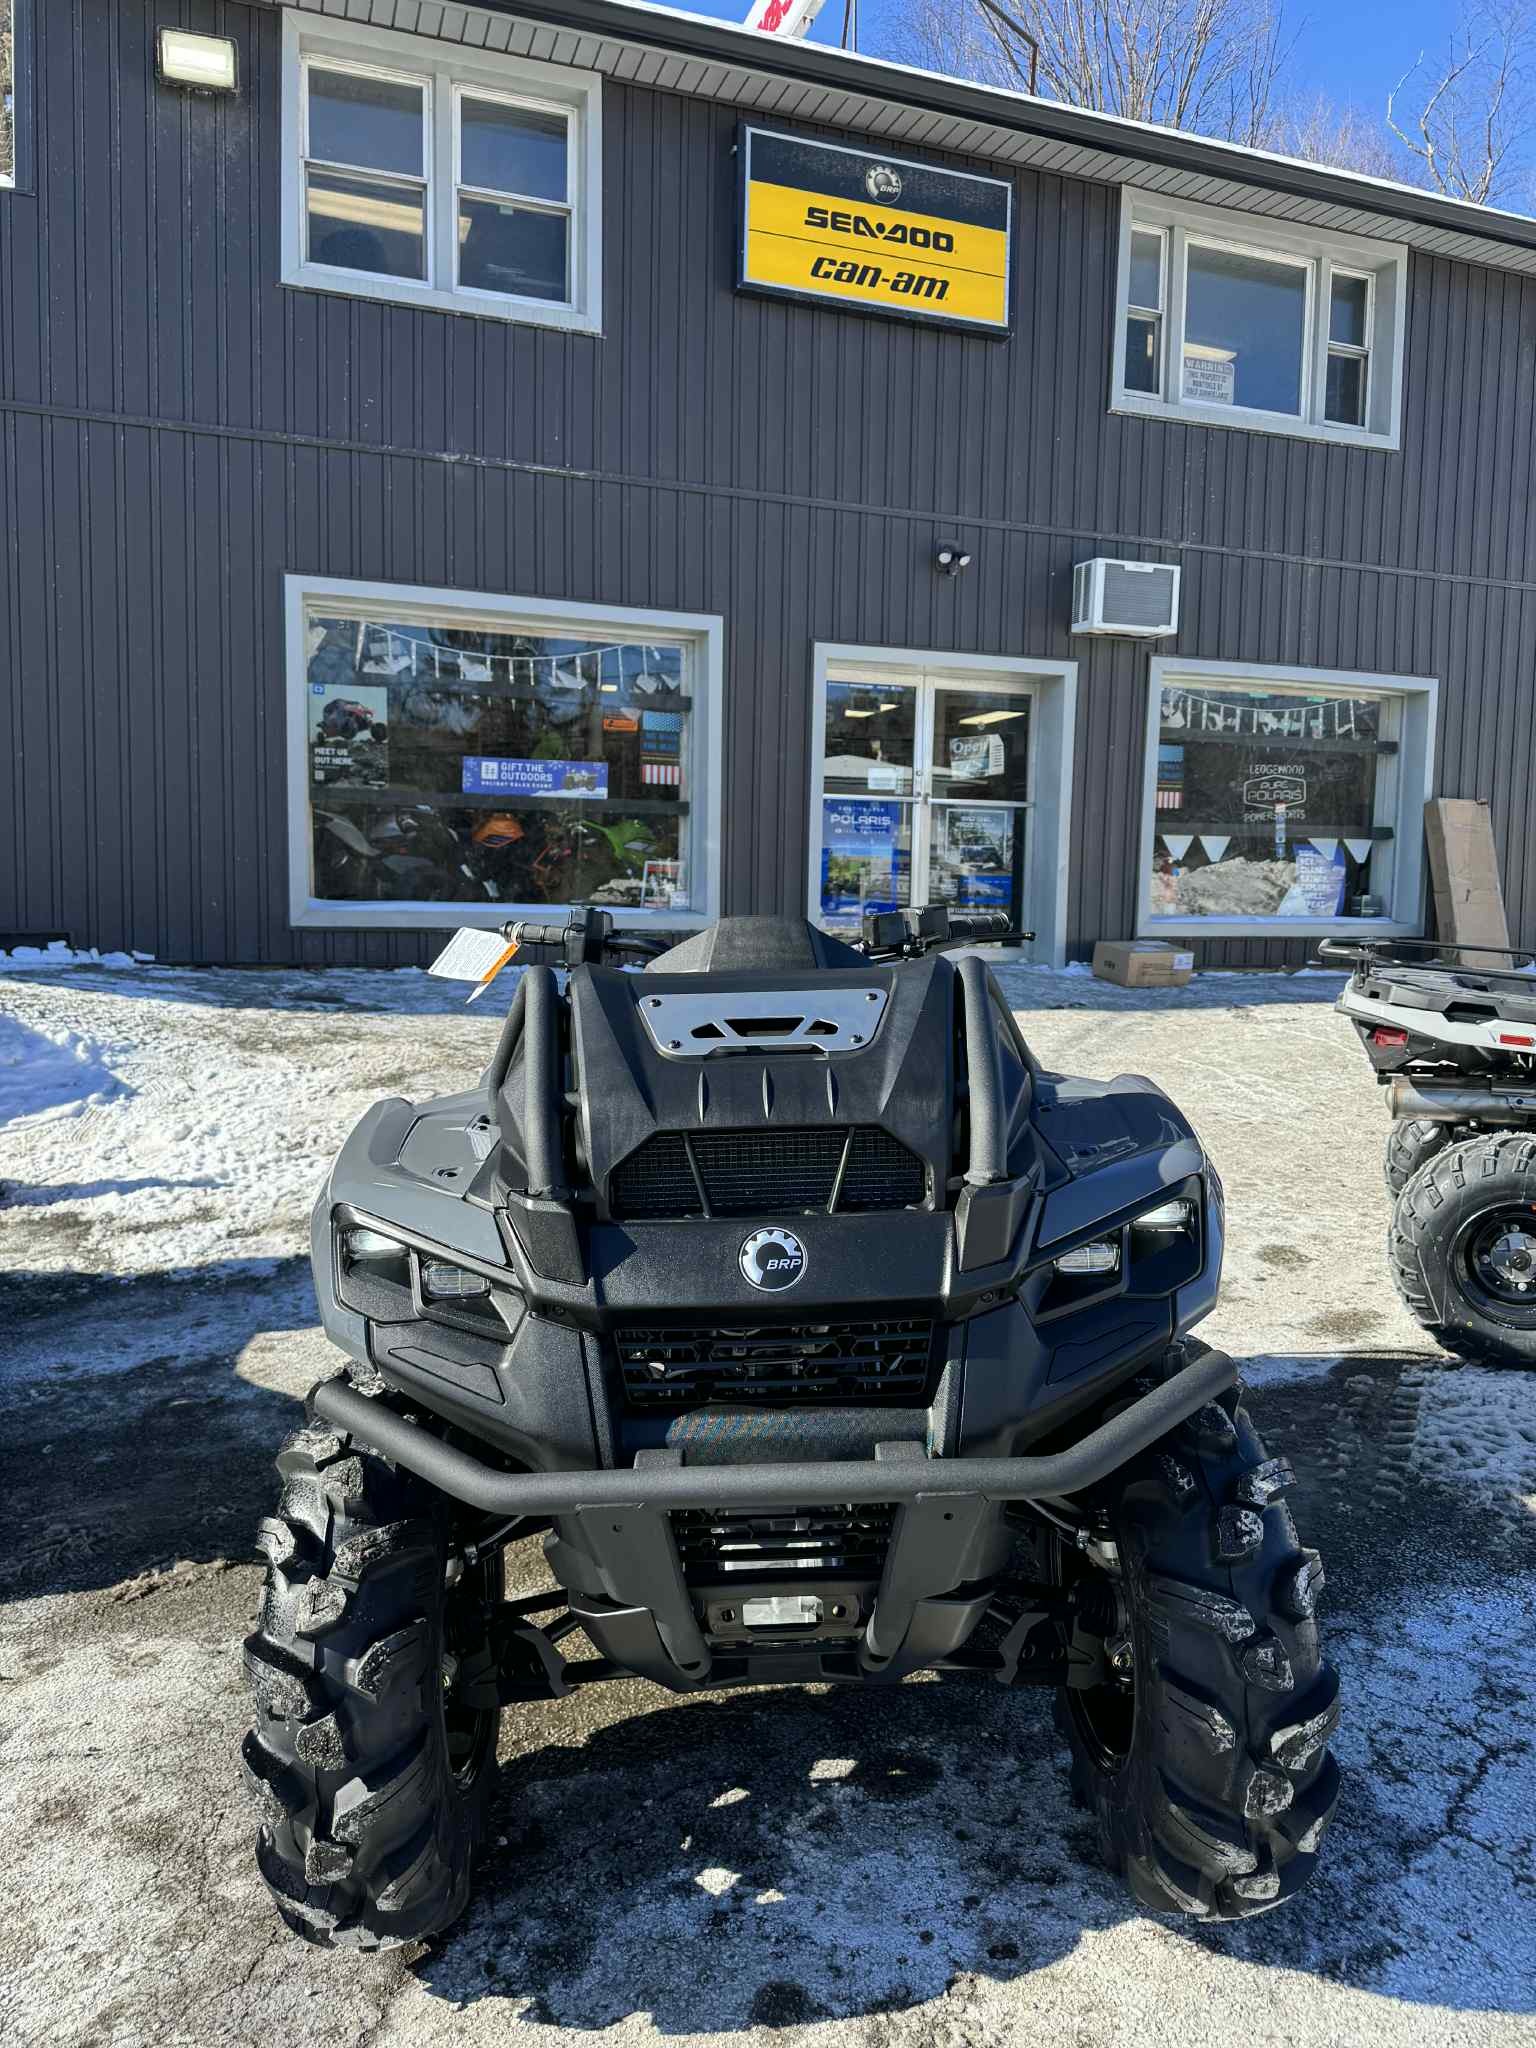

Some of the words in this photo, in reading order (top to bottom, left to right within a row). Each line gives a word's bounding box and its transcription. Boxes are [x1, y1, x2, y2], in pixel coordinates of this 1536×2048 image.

[314, 747, 335, 756] MEET
[337, 748, 348, 756] US
[314, 757, 331, 765] OUT
[501, 762, 523, 772] GIFT
[526, 763, 544, 773] THE
[1249, 764, 1305, 775] LEDGEWOOD
[501, 773, 553, 782] OUTDOORS
[1260, 780, 1289, 790] PURE
[1247, 790, 1302, 801] POLARIS
[830, 814, 891, 826] POLARIS
[766, 1258, 802, 1270] BRP
